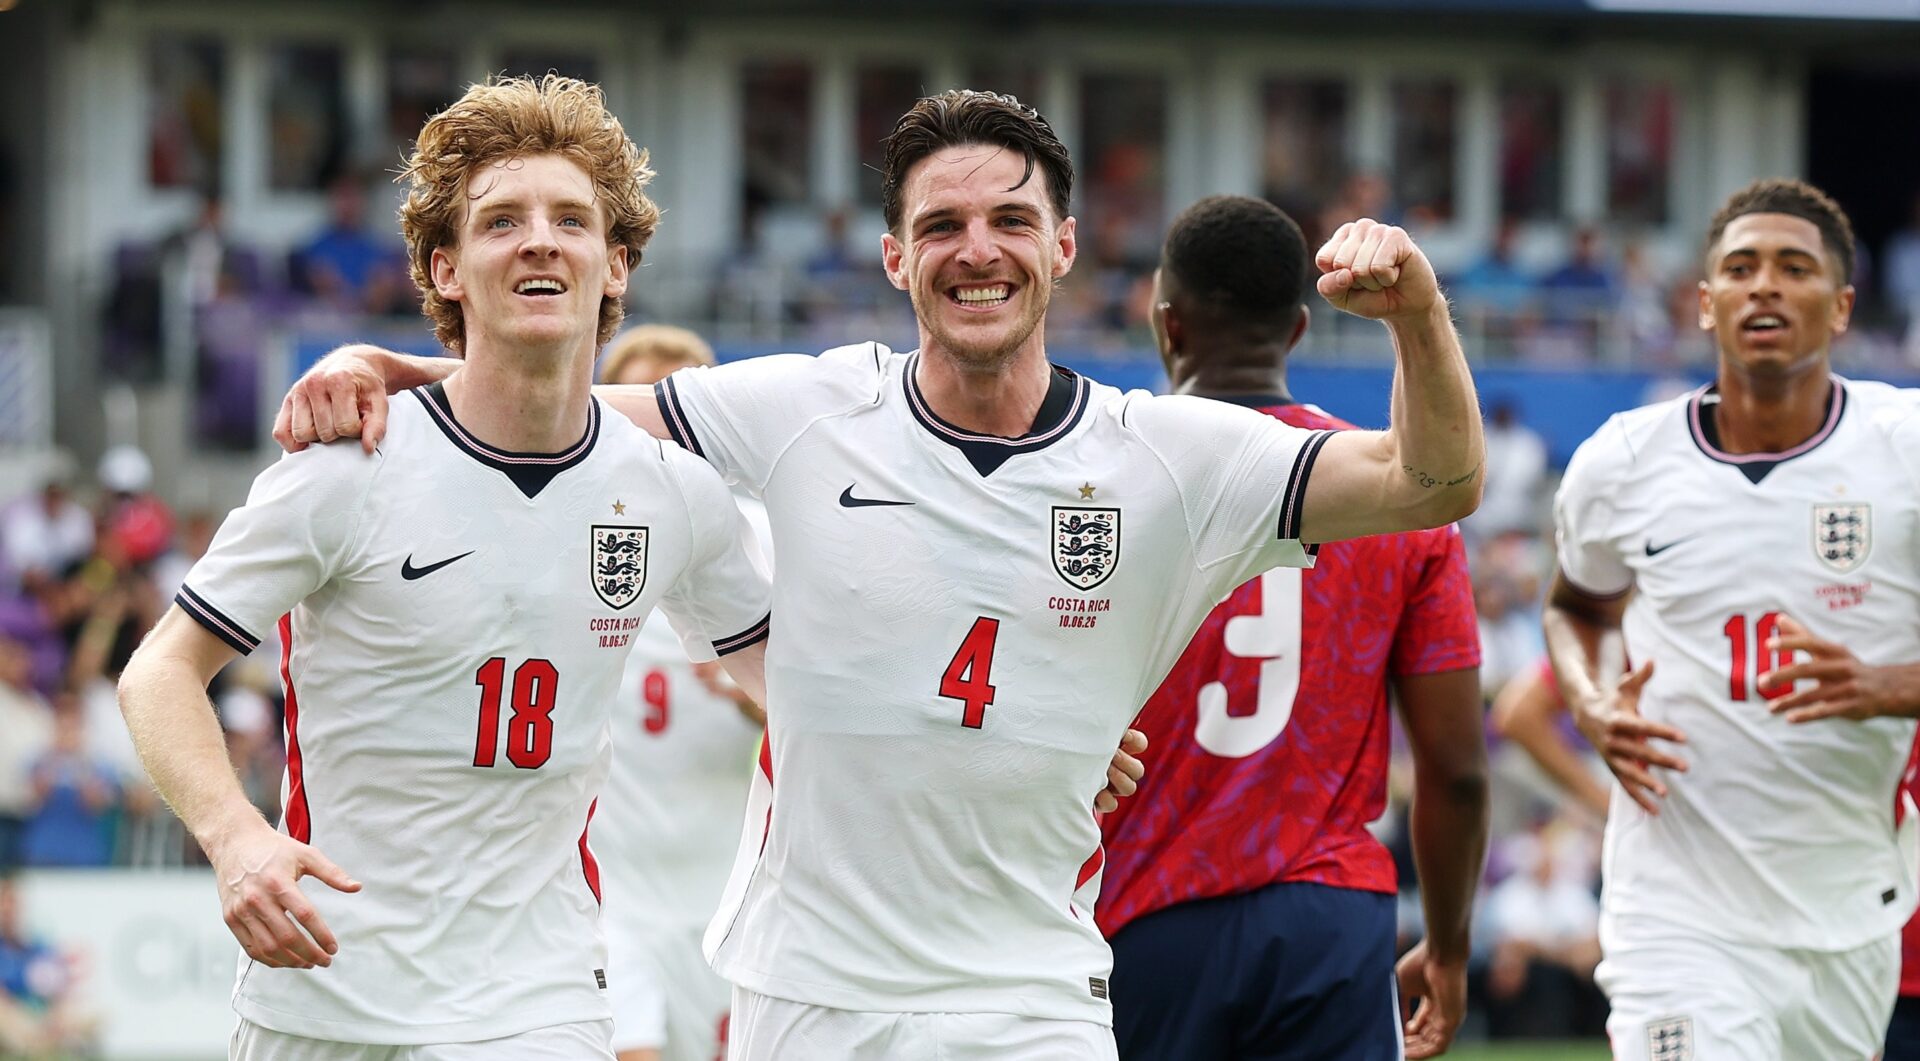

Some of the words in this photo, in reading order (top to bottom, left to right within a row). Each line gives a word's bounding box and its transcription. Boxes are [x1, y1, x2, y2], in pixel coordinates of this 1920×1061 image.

[590, 618, 620, 631] COSTA
[622, 616, 640, 630] RICA
[1048, 596, 1085, 612] COSTA
[1087, 599, 1110, 612] RICA
[1059, 614, 1096, 628] 10.06.26
[938, 616, 1000, 729] 4
[1724, 612, 1794, 701] 10
[473, 657, 559, 769] 18
[643, 669, 668, 735] 9
